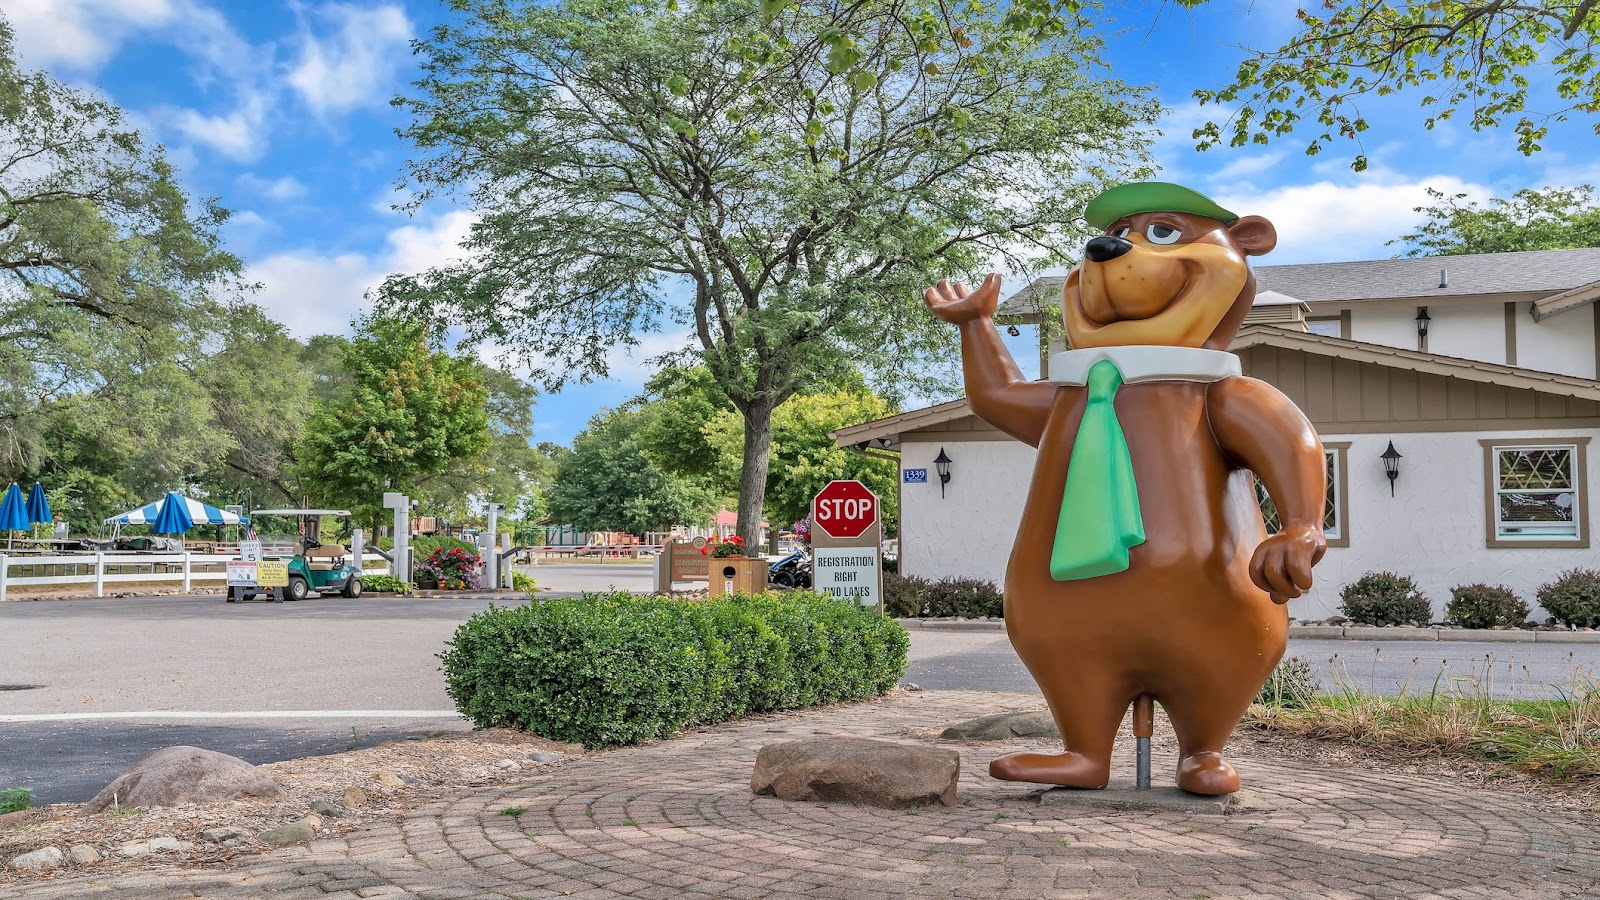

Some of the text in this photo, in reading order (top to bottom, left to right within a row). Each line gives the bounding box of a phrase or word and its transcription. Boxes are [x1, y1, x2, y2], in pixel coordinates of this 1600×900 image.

[906, 470, 925, 479] 1339
[818, 498, 872, 520] STOP
[248, 553, 256, 561] 5
[818, 556, 874, 568] REGISTRATION
[834, 571, 858, 582] RIGHT
[823, 586, 870, 597] TWO LANES
